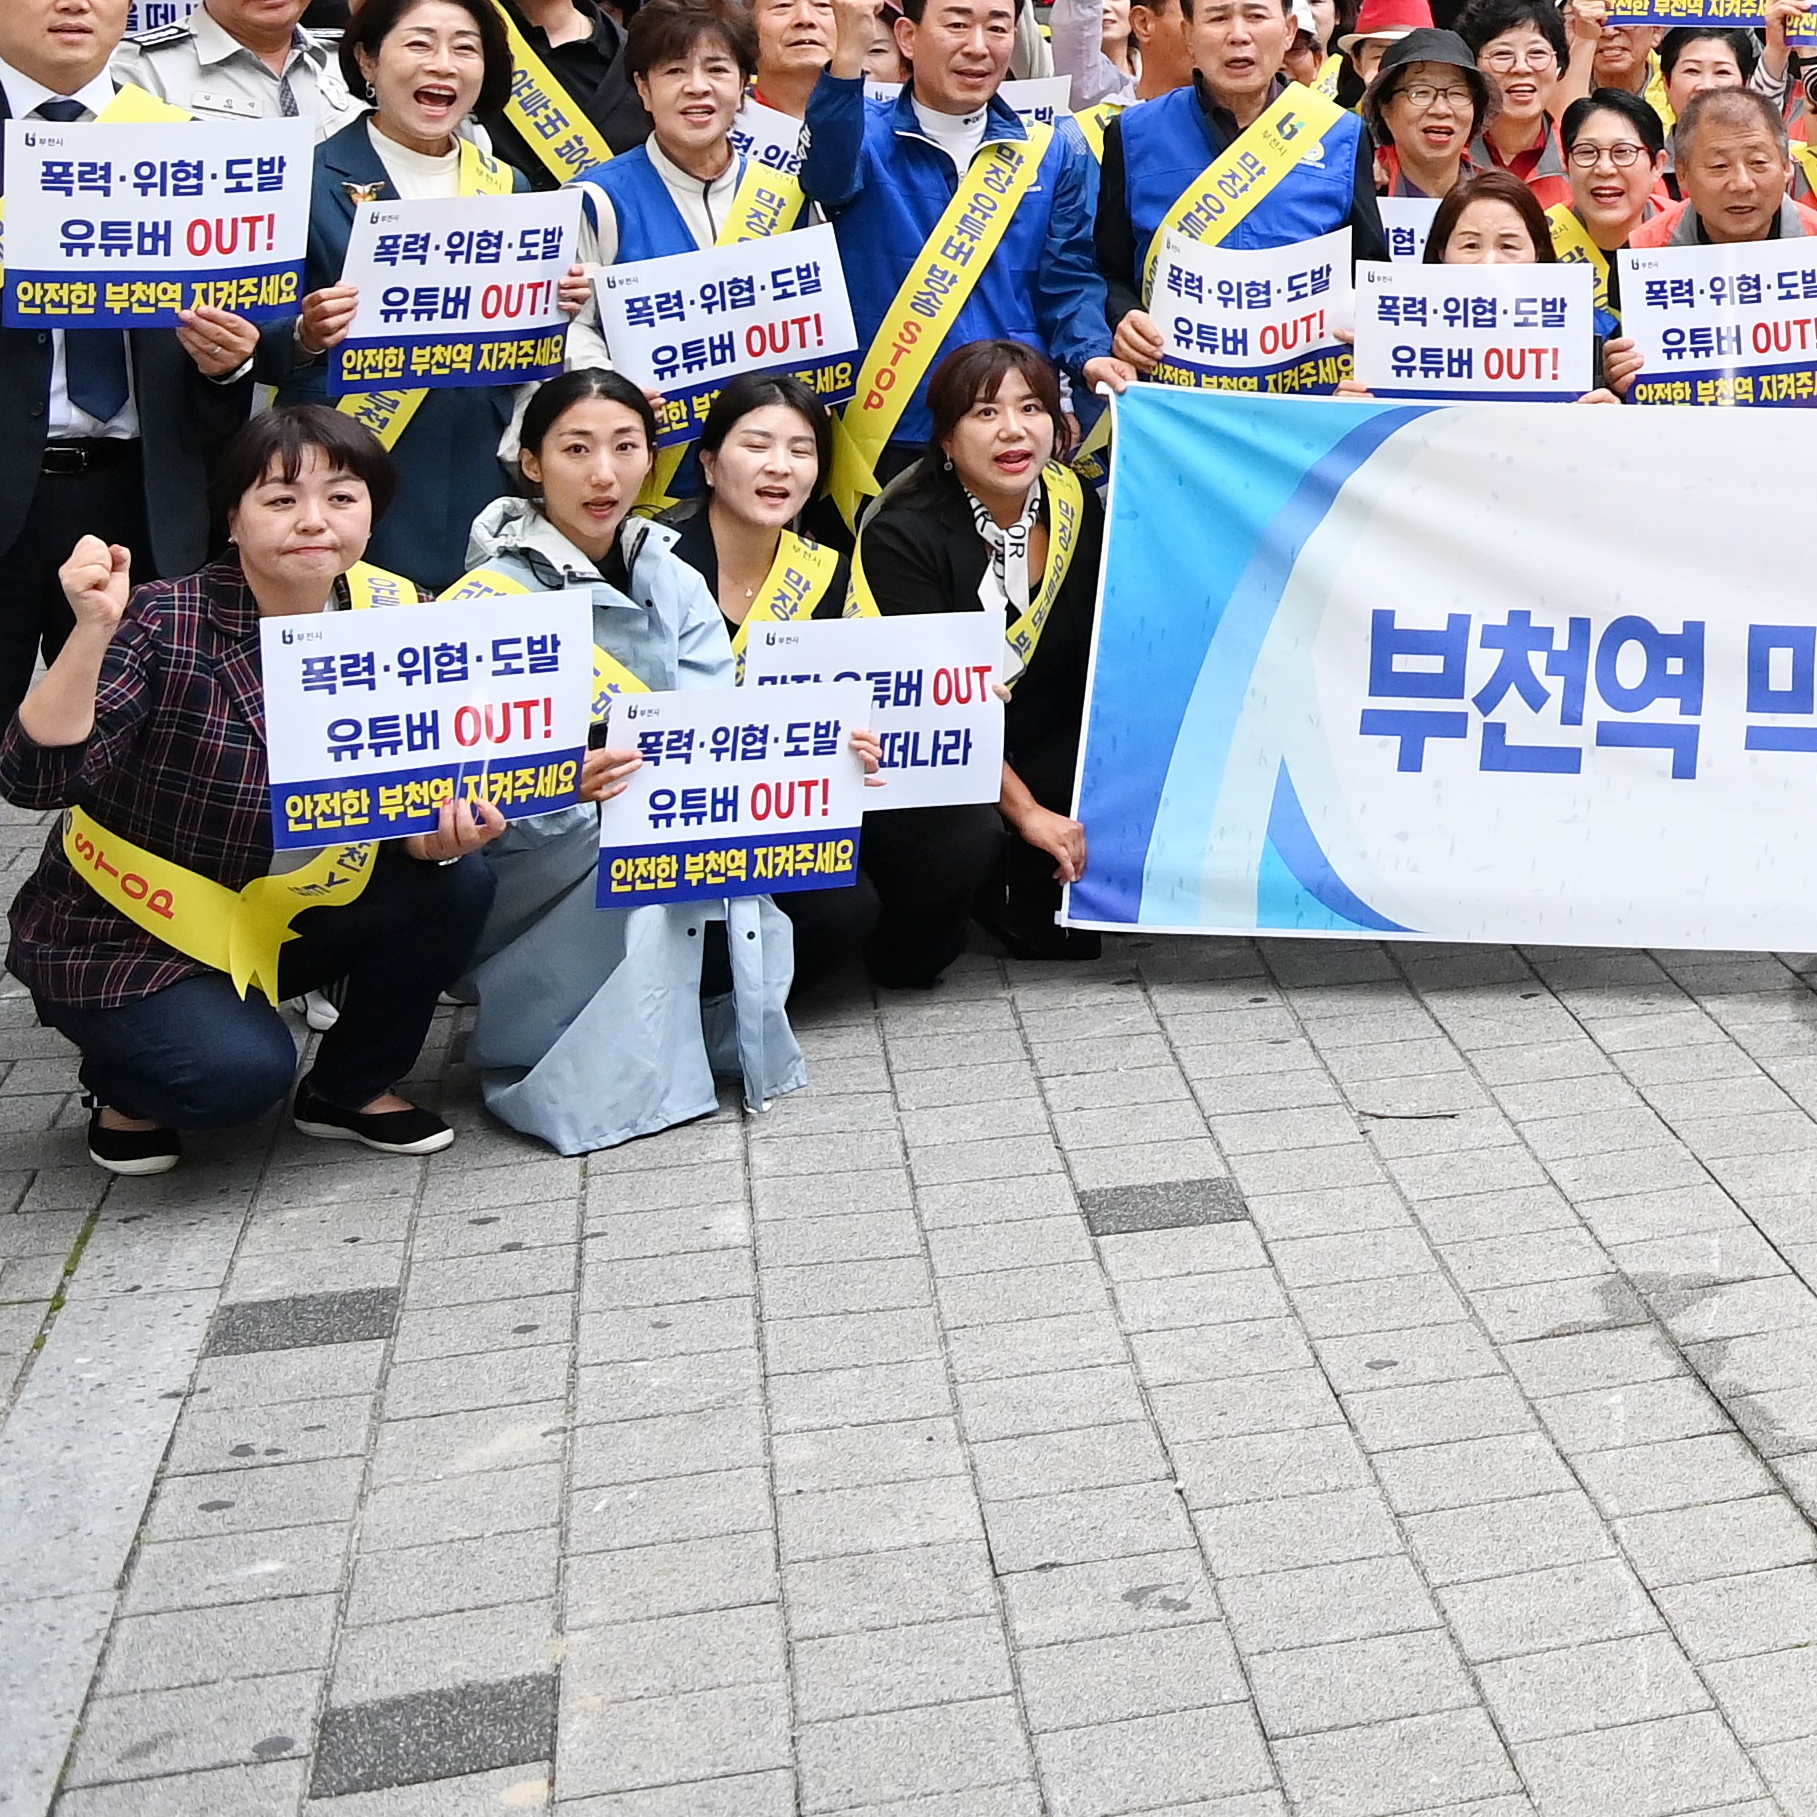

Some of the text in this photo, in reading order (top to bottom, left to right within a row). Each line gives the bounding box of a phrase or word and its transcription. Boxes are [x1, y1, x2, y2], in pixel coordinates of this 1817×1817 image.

[41, 156, 286, 197] 폭력·위협·도발
[60, 214, 275, 257] 유튜버 OUT!
[374, 226, 563, 266] 폭력·위협·도발
[18, 271, 299, 314] 안전한 부천역 지켜주세요
[862, 141, 1026, 413] 막장 유튜버 방송 STOP
[380, 281, 551, 323] 유튜버 OUT!
[1378, 296, 1567, 328] 폭력·위협·도발
[343, 335, 563, 380] 안전한 부천역 지켜주세요
[1392, 346, 1558, 380] 유튜버 OUT!
[1360, 609, 1705, 779] 부천역
[72, 831, 176, 921] STOP
